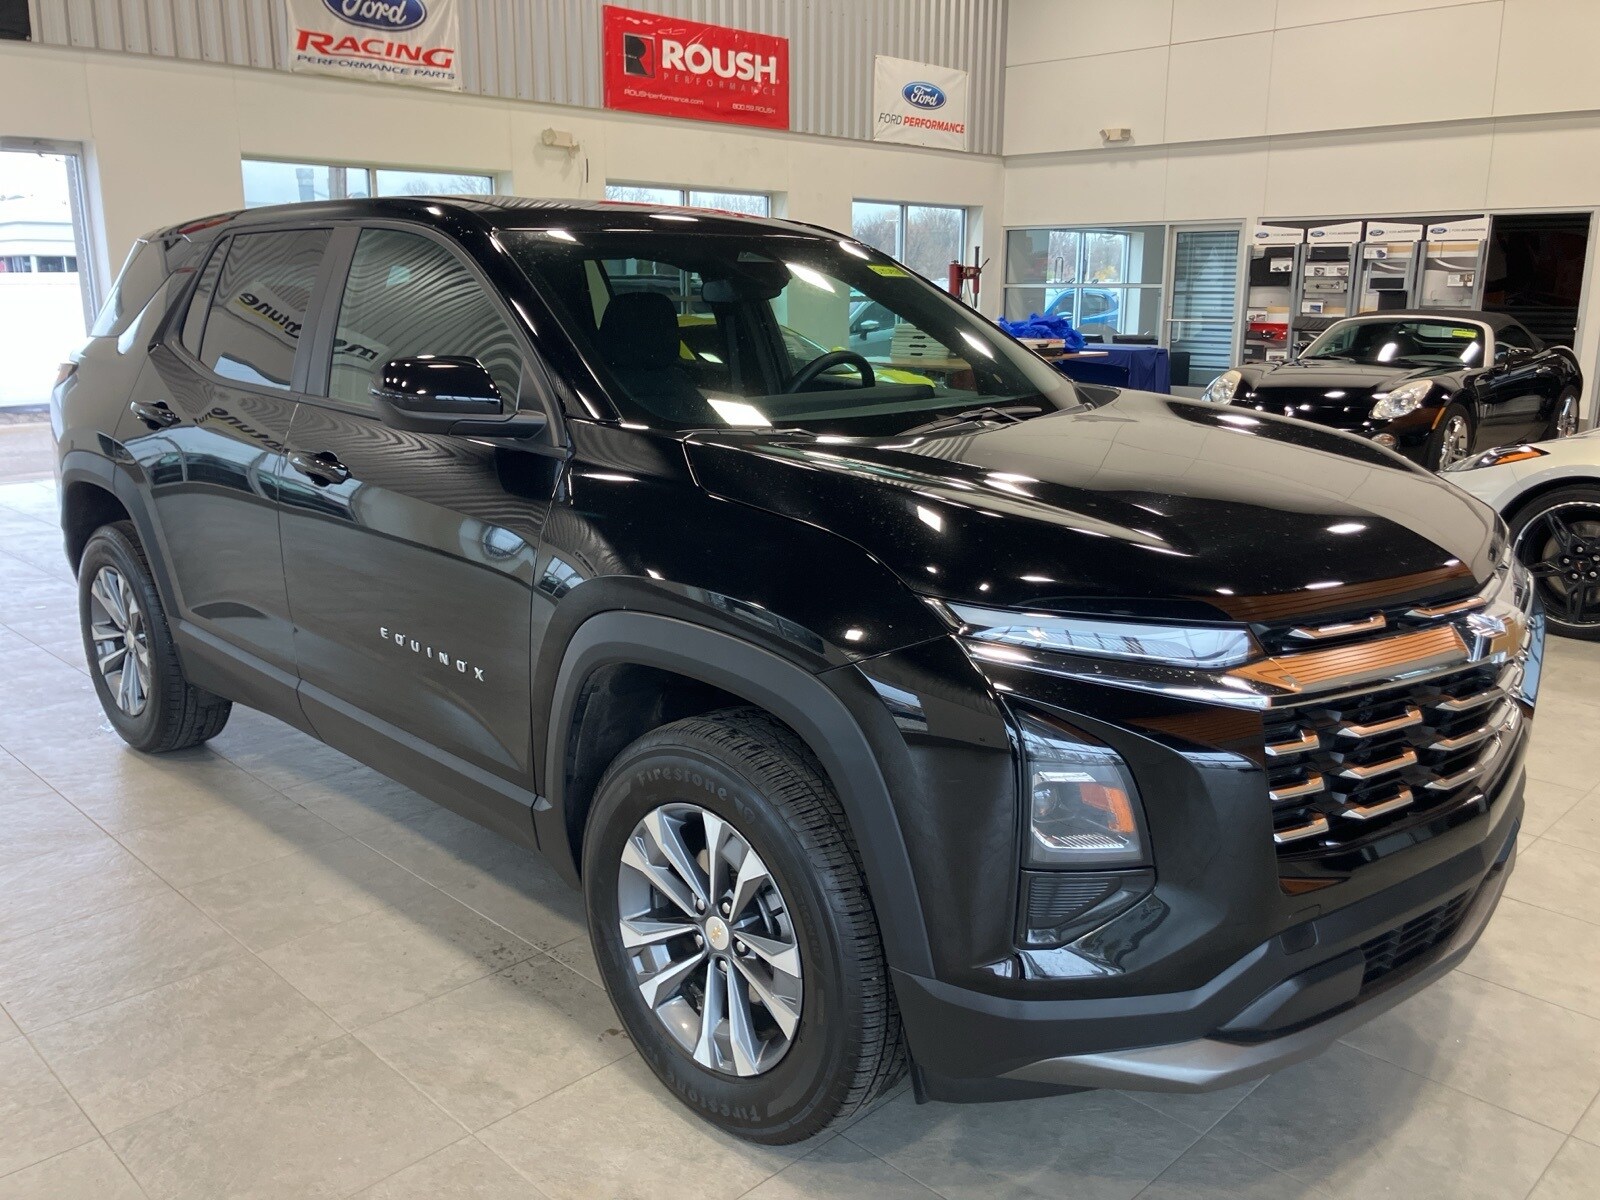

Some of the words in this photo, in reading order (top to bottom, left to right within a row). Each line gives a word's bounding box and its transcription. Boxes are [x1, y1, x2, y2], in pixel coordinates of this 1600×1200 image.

[296, 29, 454, 69] RACING
[661, 39, 777, 84] ROUSH
[297, 55, 409, 76] PERFORMANCE
[413, 68, 455, 80] PARTS
[663, 73, 777, 96] PERFORMANCE
[910, 85, 939, 106] Ford
[878, 112, 902, 125] FORD
[902, 115, 965, 134] PERFORMANCE
[380, 626, 484, 682] EQUINOX
[636, 767, 728, 801] Firestone
